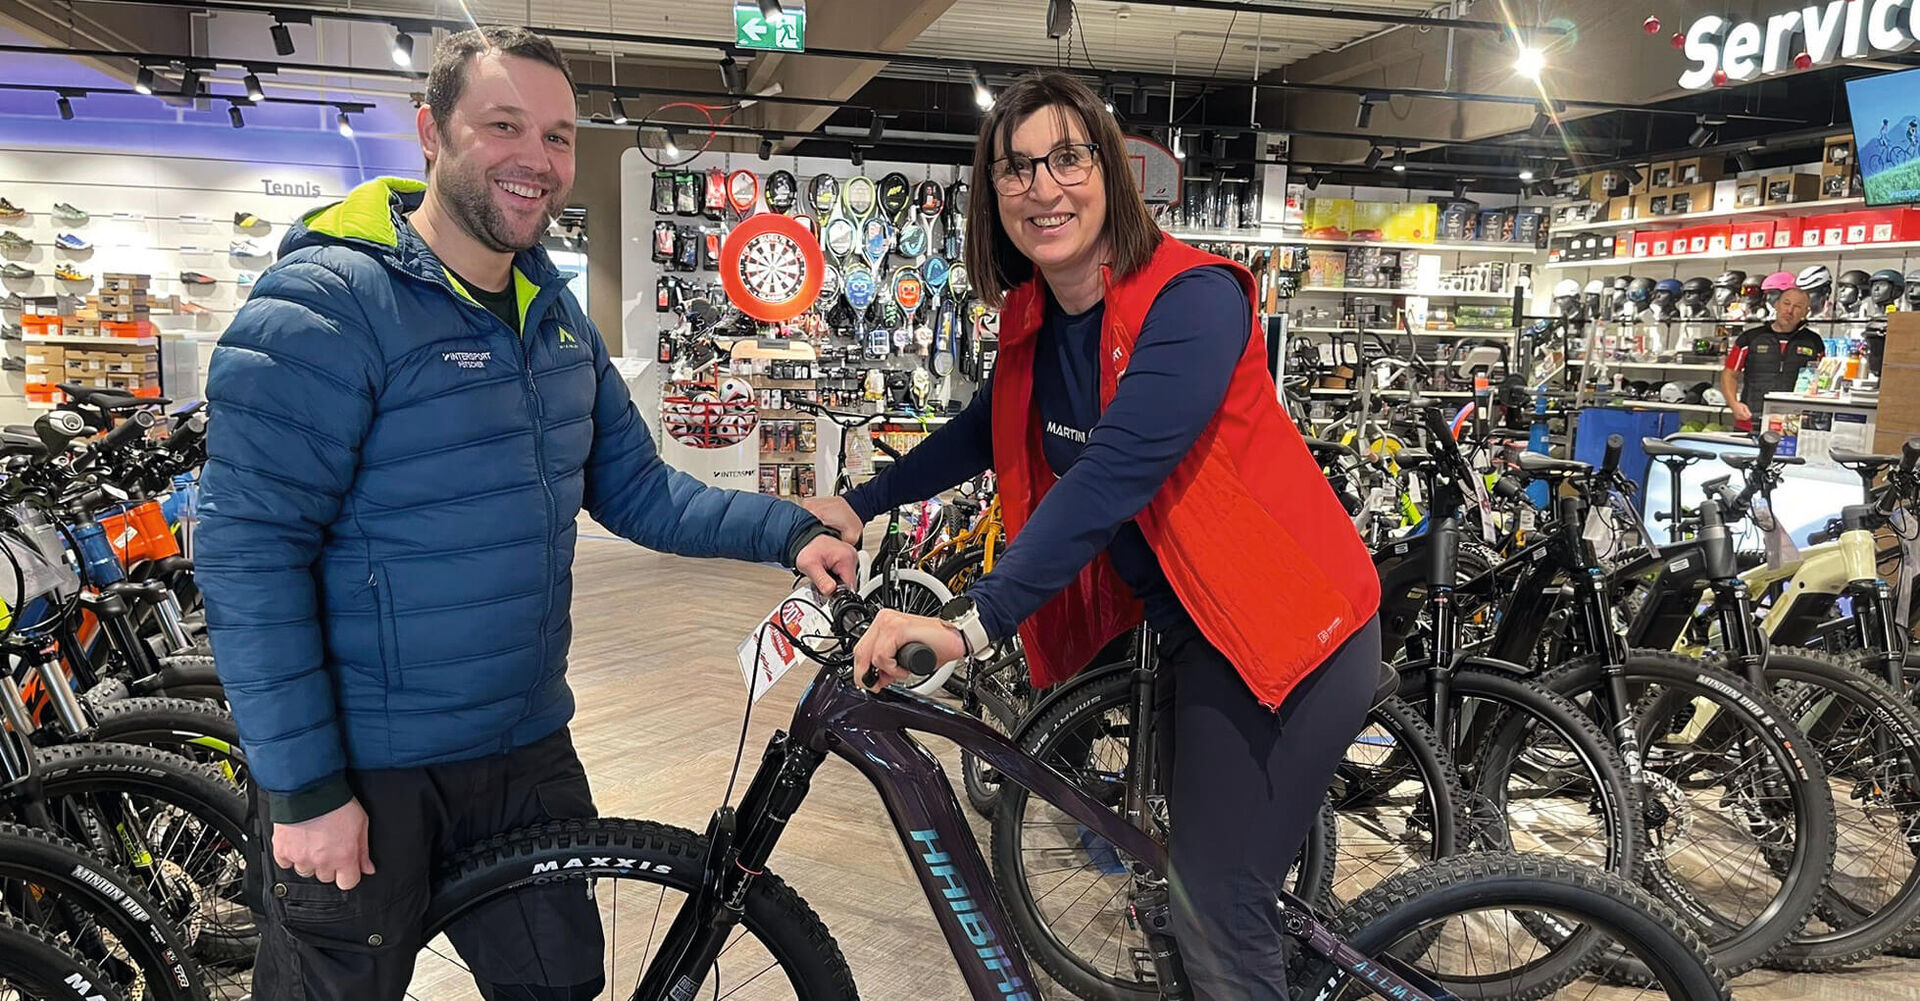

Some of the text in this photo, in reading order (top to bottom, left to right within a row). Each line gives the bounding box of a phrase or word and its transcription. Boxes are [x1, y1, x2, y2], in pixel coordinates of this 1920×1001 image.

[1678, 0, 1920, 90] Servic
[261, 179, 321, 198] Tennis
[1046, 421, 1086, 443] MARTIN
[1874, 706, 1914, 747] DT SWISS
[71, 864, 126, 901] MINION
[532, 857, 672, 875] MAXXIS
[910, 829, 1034, 1001] HAIBIK
